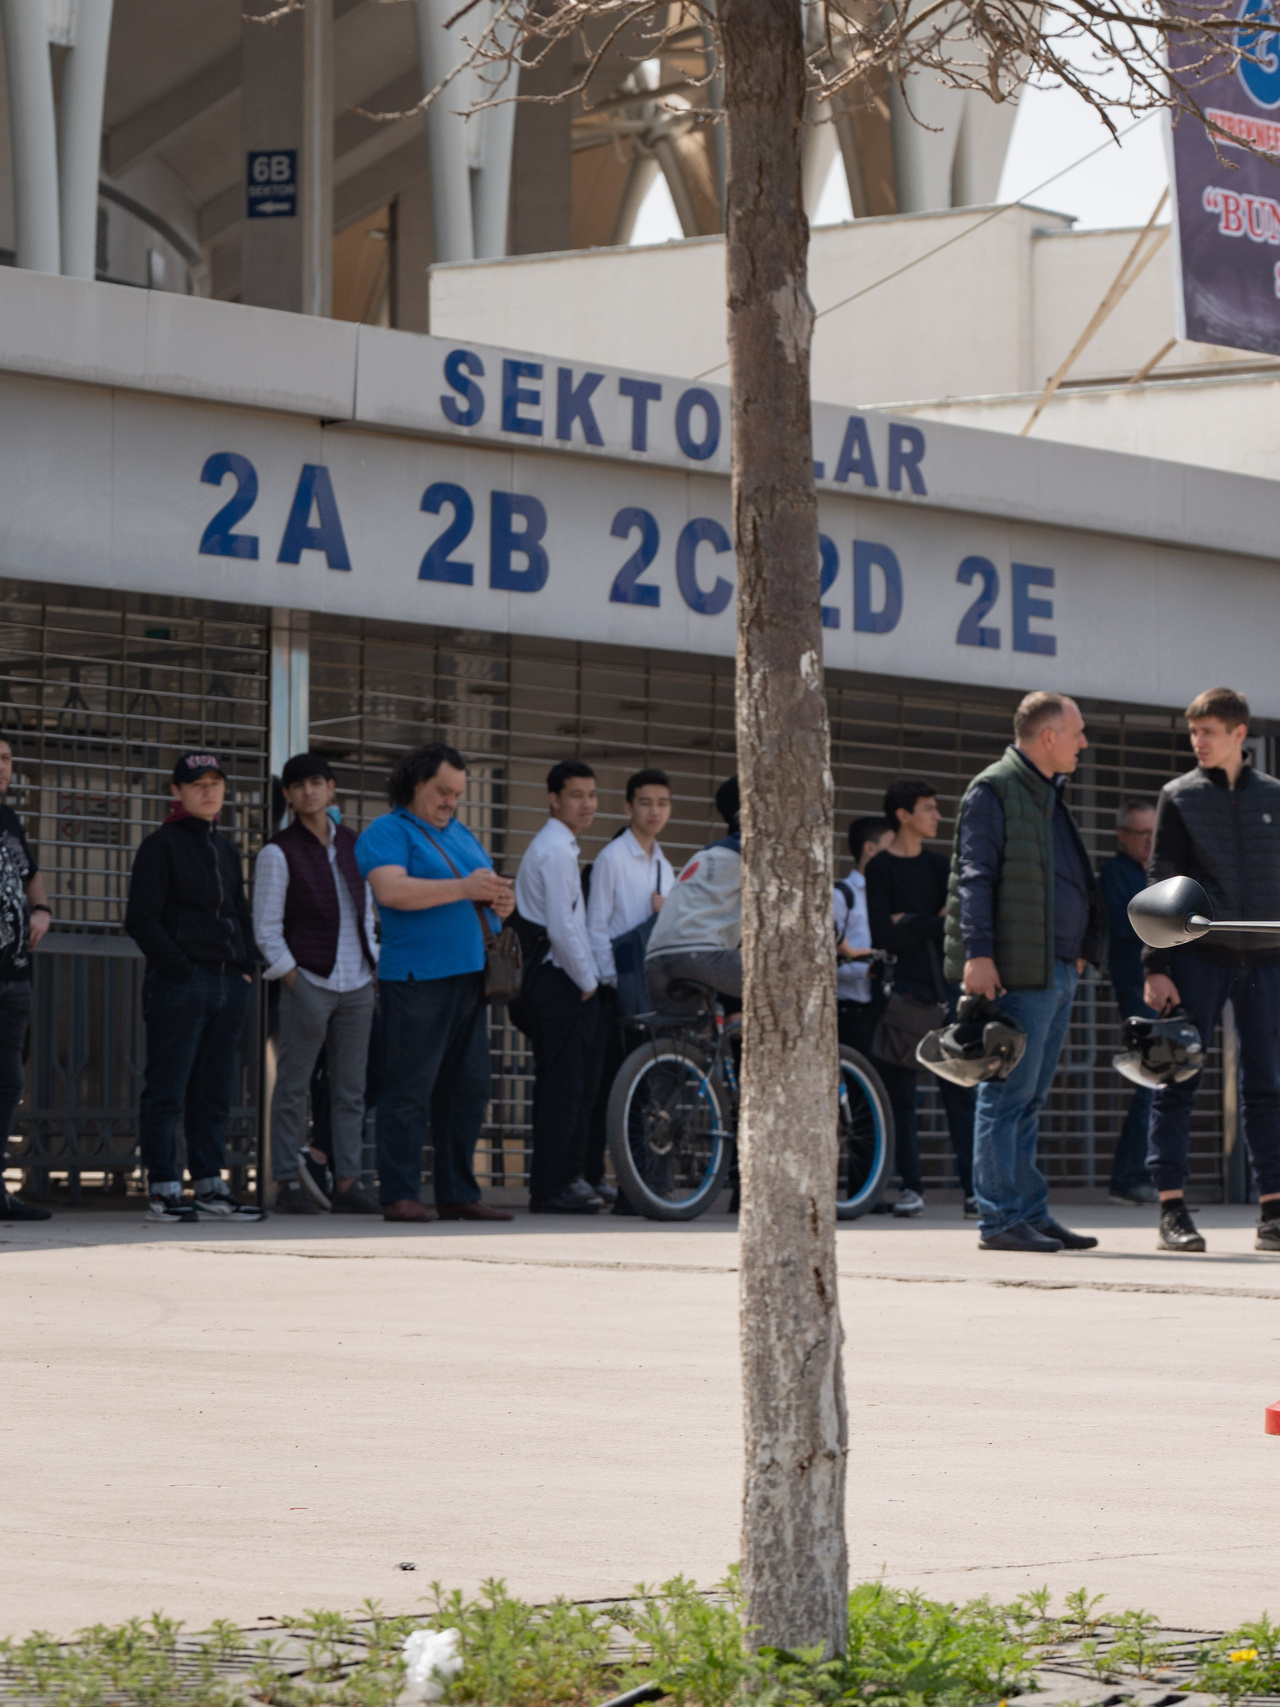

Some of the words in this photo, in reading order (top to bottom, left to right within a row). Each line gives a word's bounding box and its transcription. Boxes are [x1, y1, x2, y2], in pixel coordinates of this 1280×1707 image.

[252, 154, 291, 182] 6B
[199, 451, 352, 571] 2A
[418, 481, 549, 592] 2B
[608, 506, 735, 616] 2C
[955, 555, 1057, 656] 2E
